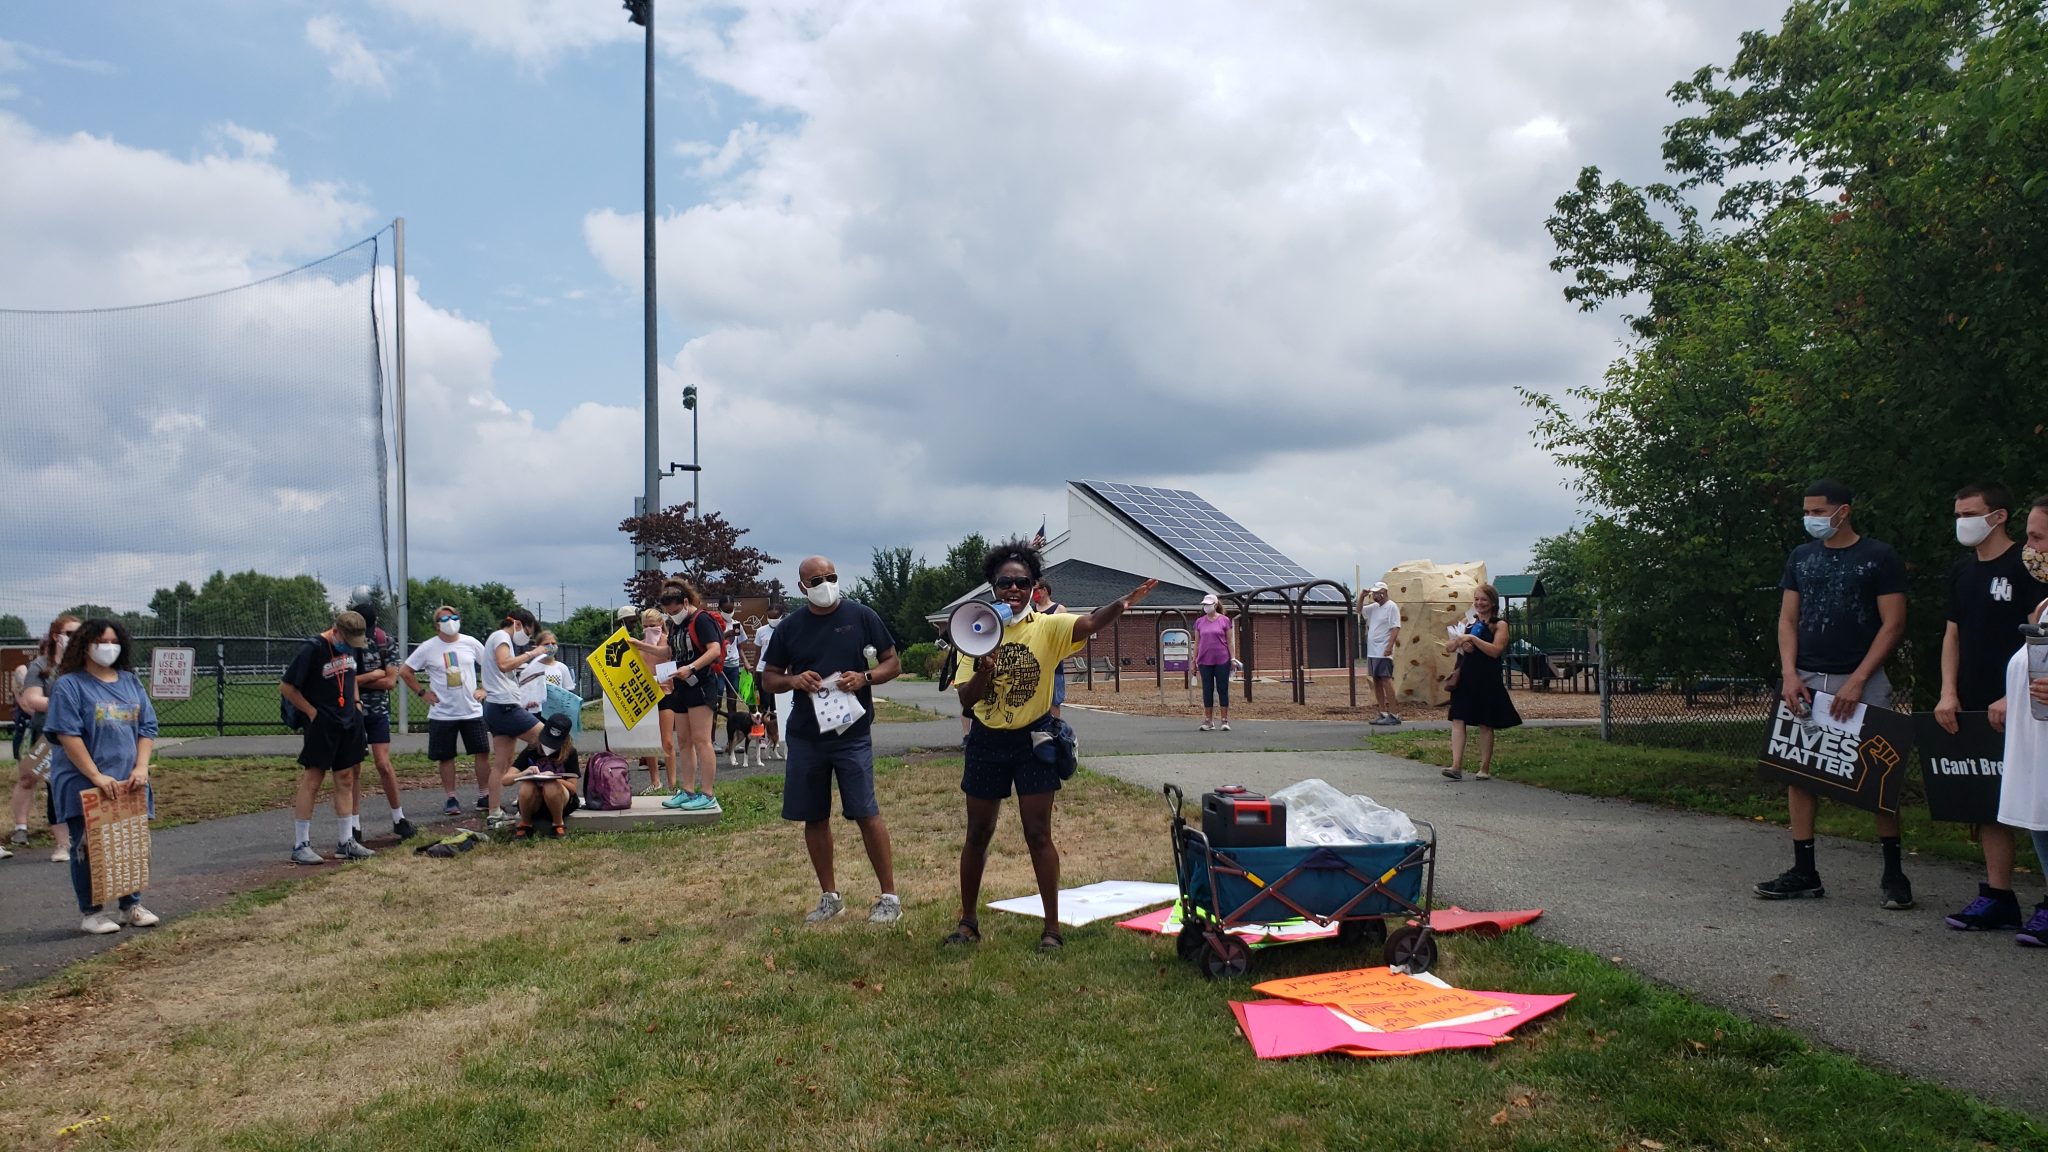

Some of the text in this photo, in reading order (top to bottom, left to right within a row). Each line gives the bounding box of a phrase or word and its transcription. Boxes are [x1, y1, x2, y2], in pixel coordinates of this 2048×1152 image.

[163, 652, 185, 660] FIELD
[162, 677, 181, 685] ONLY
[628, 678, 650, 710] LIVES
[629, 659, 657, 703] MATTER
[618, 682, 642, 717] BLACK
[1772, 719, 1859, 763] LIVES
[1768, 740, 1855, 780] MATTER
[1931, 757, 1938, 775] I
[1940, 757, 1978, 775] Can't
[82, 793, 100, 829] ALL
